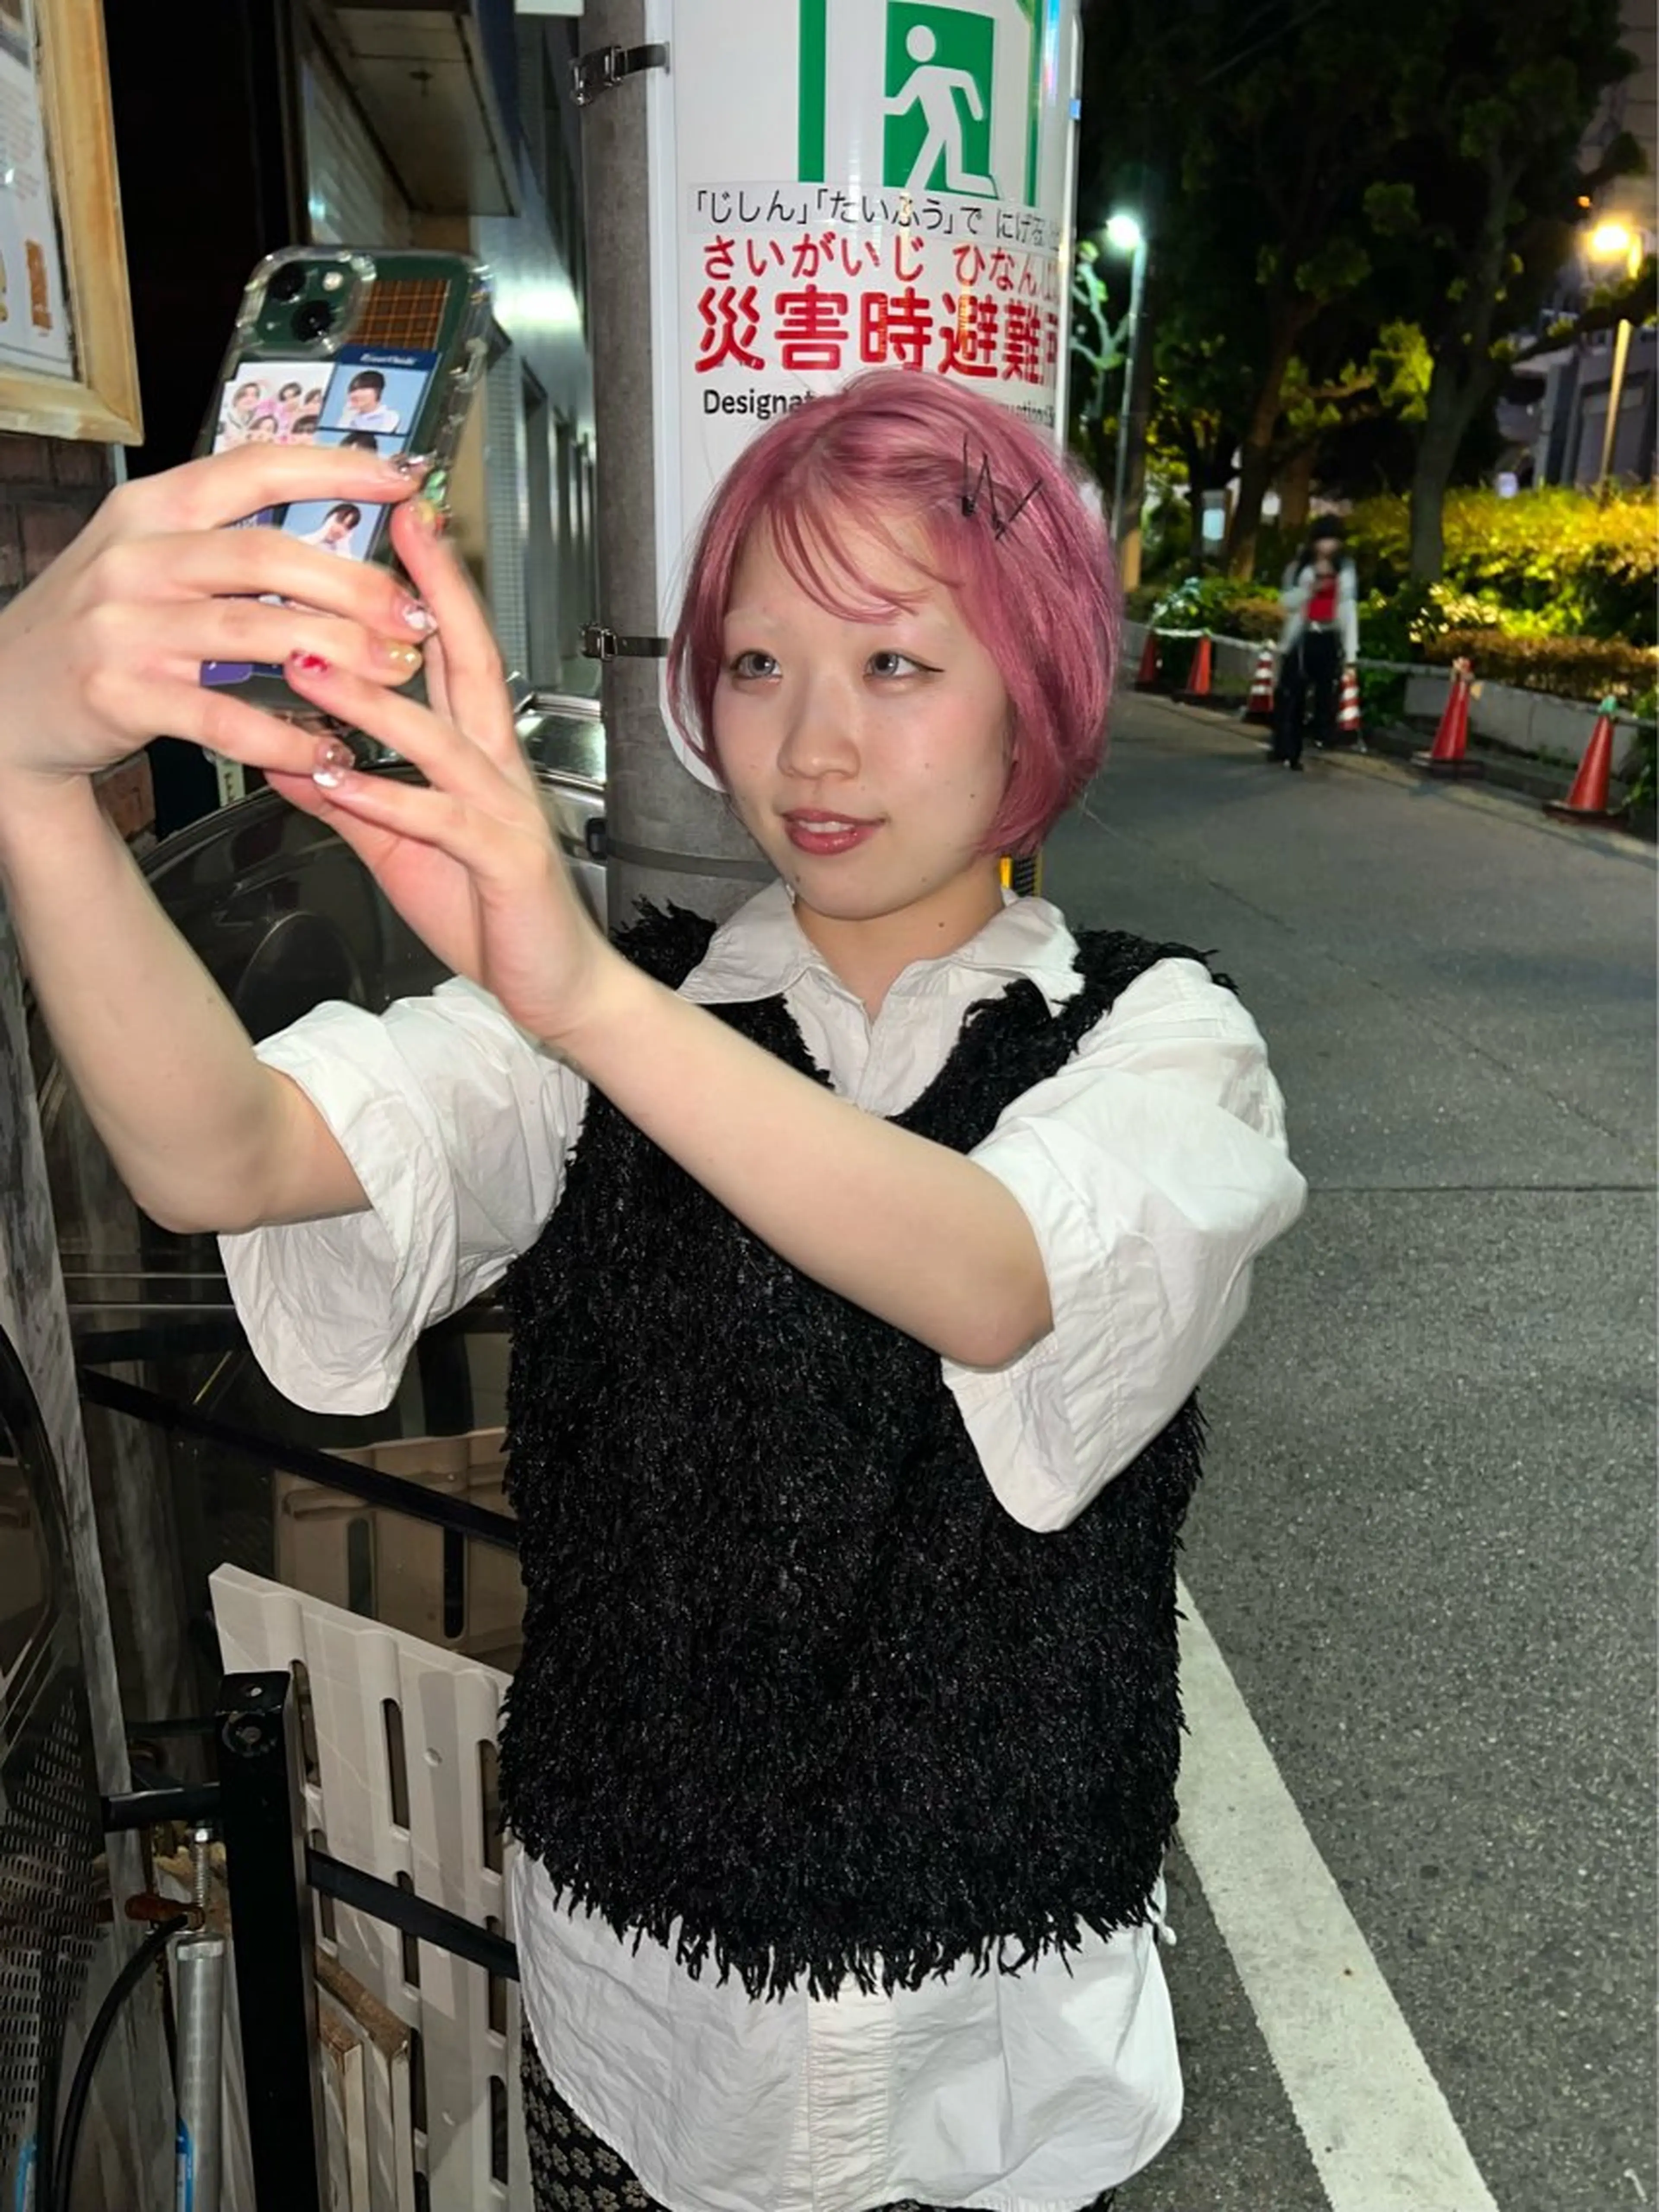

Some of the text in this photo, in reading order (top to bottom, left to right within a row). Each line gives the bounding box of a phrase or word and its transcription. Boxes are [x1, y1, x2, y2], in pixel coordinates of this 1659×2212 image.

[704, 232, 925, 281] さいがいじ
